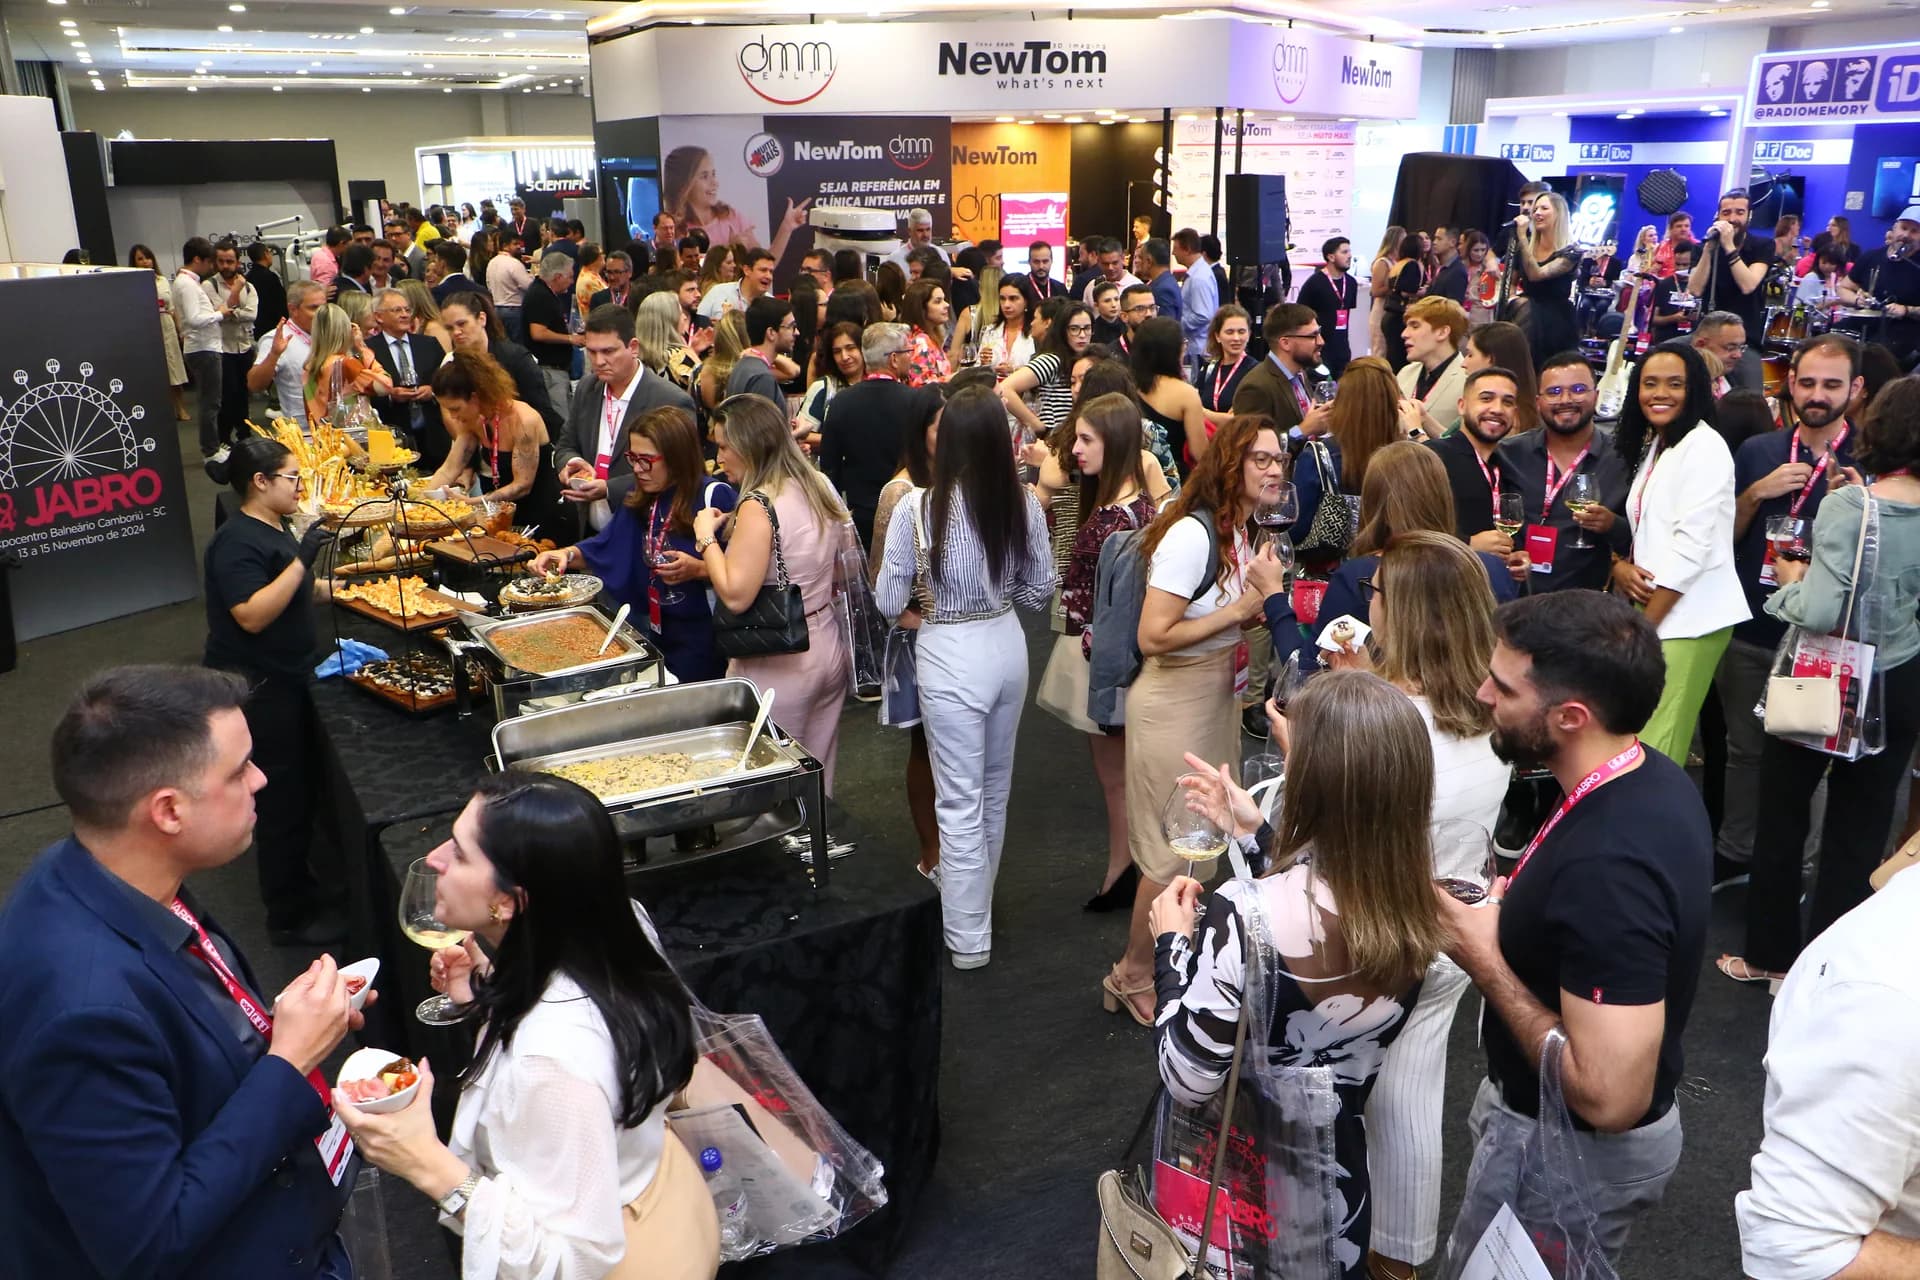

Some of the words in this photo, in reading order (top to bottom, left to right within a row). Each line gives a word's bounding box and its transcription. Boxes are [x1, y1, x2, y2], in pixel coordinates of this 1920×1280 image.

[740, 33, 833, 72] dmm
[938, 41, 1107, 75] NewTom
[746, 71, 831, 81] HEALTH
[1341, 55, 1392, 89] NewTom
[997, 77, 1054, 89] what's
[1064, 77, 1104, 89] next
[1754, 103, 1869, 120] @RADIOMEMORY
[754, 137, 776, 155] MUITO
[794, 140, 883, 161] NewTom
[951, 145, 1038, 166] NewTom
[1532, 146, 1553, 161] iDoc
[1612, 146, 1632, 161] iDoc
[1784, 145, 1812, 159] iDoc
[760, 146, 781, 168] MAIS
[525, 178, 592, 192] SCIENTIFIC
[819, 182, 848, 194] SEJA
[851, 178, 921, 193] REFERÊNCIA
[923, 179, 941, 191] EM
[815, 194, 861, 208] CLÍNICA
[864, 194, 935, 207] INTELIGENTE
[938, 193, 946, 205] E
[25, 467, 163, 527] JABRO
[50, 520, 96, 538] Balneário
[97, 510, 144, 529] Camboriú
[153, 506, 167, 518] SC
[18, 547, 29, 559] 13
[31, 547, 38, 556] a
[40, 543, 51, 554] 15
[53, 533, 105, 551] Novembro
[106, 529, 119, 539] de
[122, 523, 145, 538] 2024
[1575, 771, 1601, 798] JABRO
